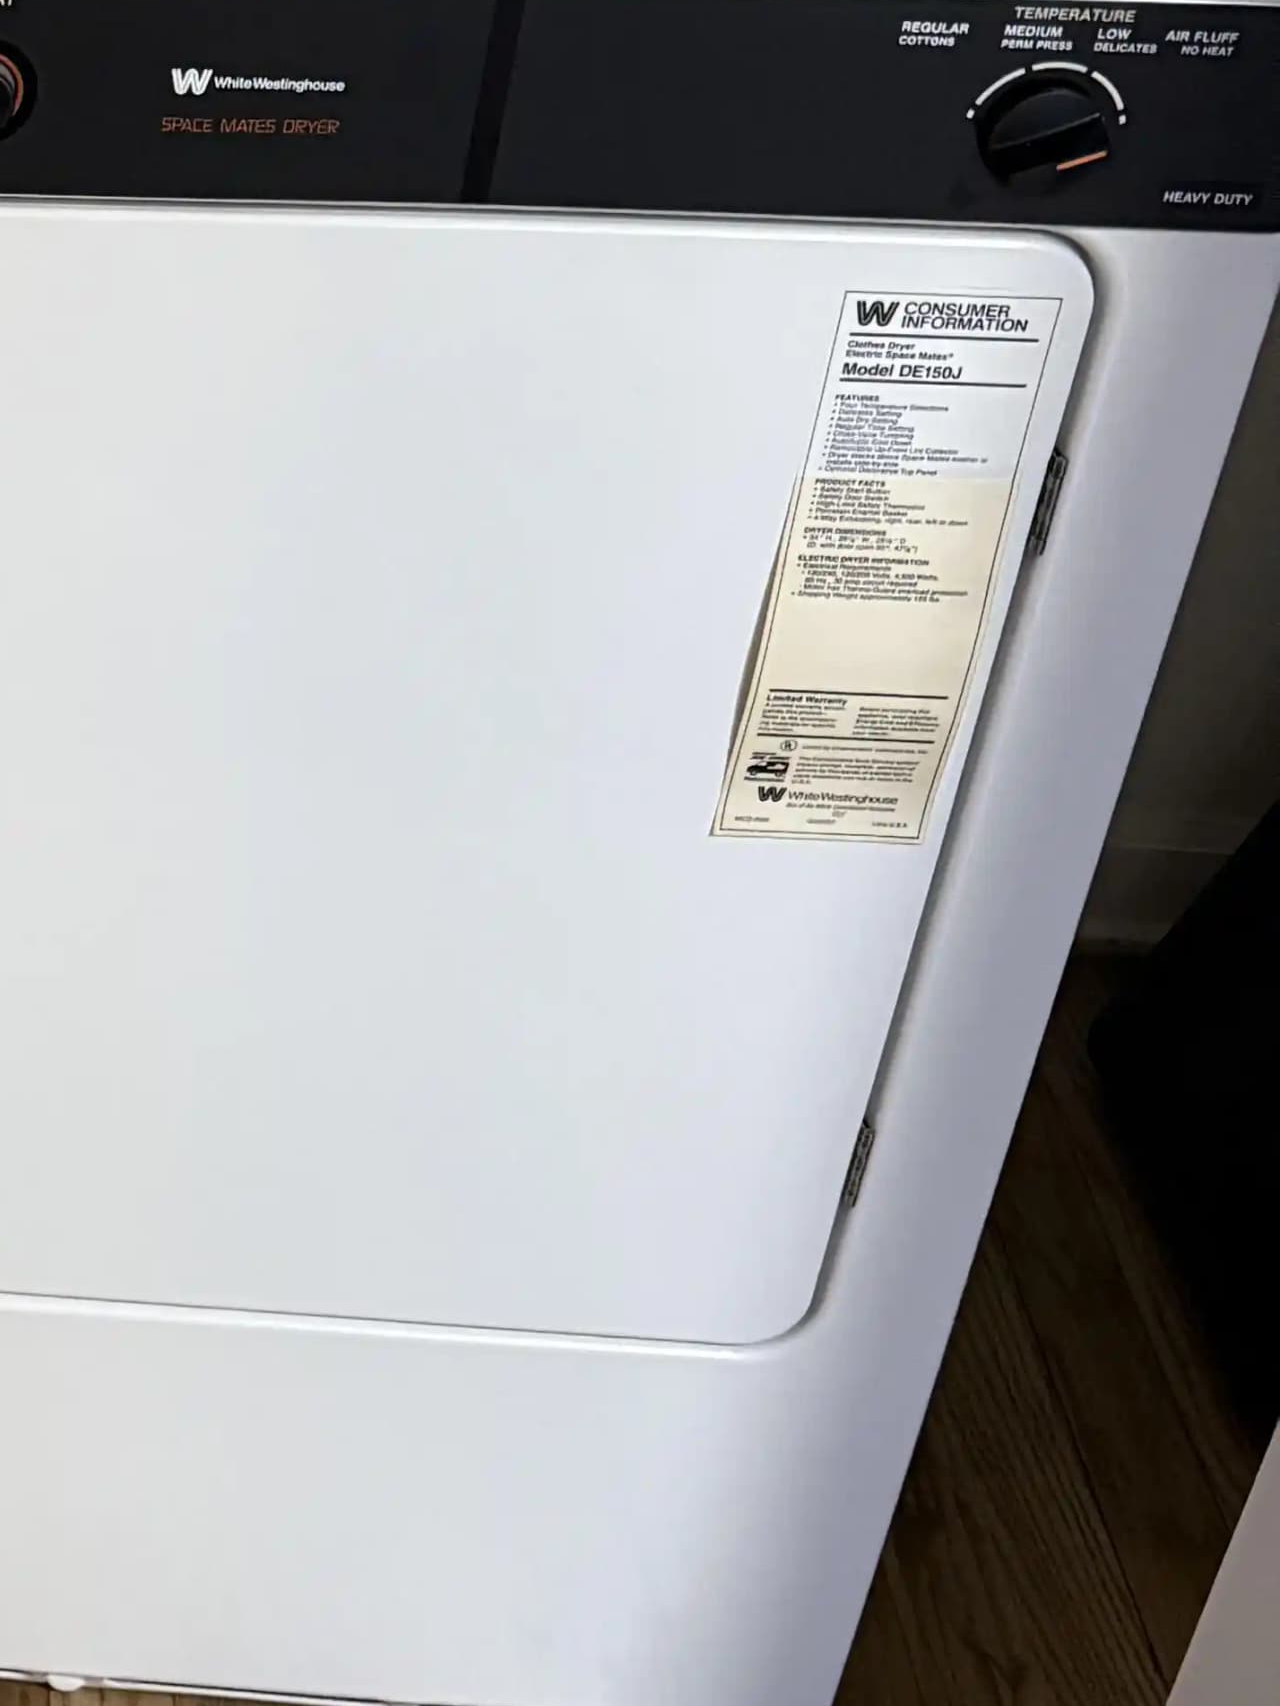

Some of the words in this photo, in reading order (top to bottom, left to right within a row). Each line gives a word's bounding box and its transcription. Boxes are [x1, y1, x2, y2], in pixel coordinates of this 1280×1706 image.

[1014, 6, 1136, 23] TEMPERATURE
[901, 21, 969, 35] REGULAR
[1004, 25, 1063, 37] MEDIUM
[1097, 28, 1132, 40] LOW
[898, 35, 955, 47] COTTONS
[1165, 30, 1190, 42] AIR
[1194, 31, 1239, 44] FLUFF
[1001, 39, 1034, 50] PERM
[1036, 40, 1073, 51] PRESS
[1094, 43, 1157, 54] DELICATES
[1181, 45, 1198, 55] NO
[1202, 46, 1233, 57] HEAT
[162, 117, 212, 132] SPACE
[221, 118, 275, 133] MATES
[283, 119, 339, 134] DRYER
[1162, 191, 1210, 204] HEAVY
[1214, 192, 1253, 206] DUTY
[904, 302, 1010, 317] CONSUMER
[901, 316, 1028, 332] INFORMATION
[847, 340, 885, 349] Clothes
[888, 341, 915, 351] Dryer
[842, 363, 894, 376] Model
[899, 365, 962, 379] DE150J
